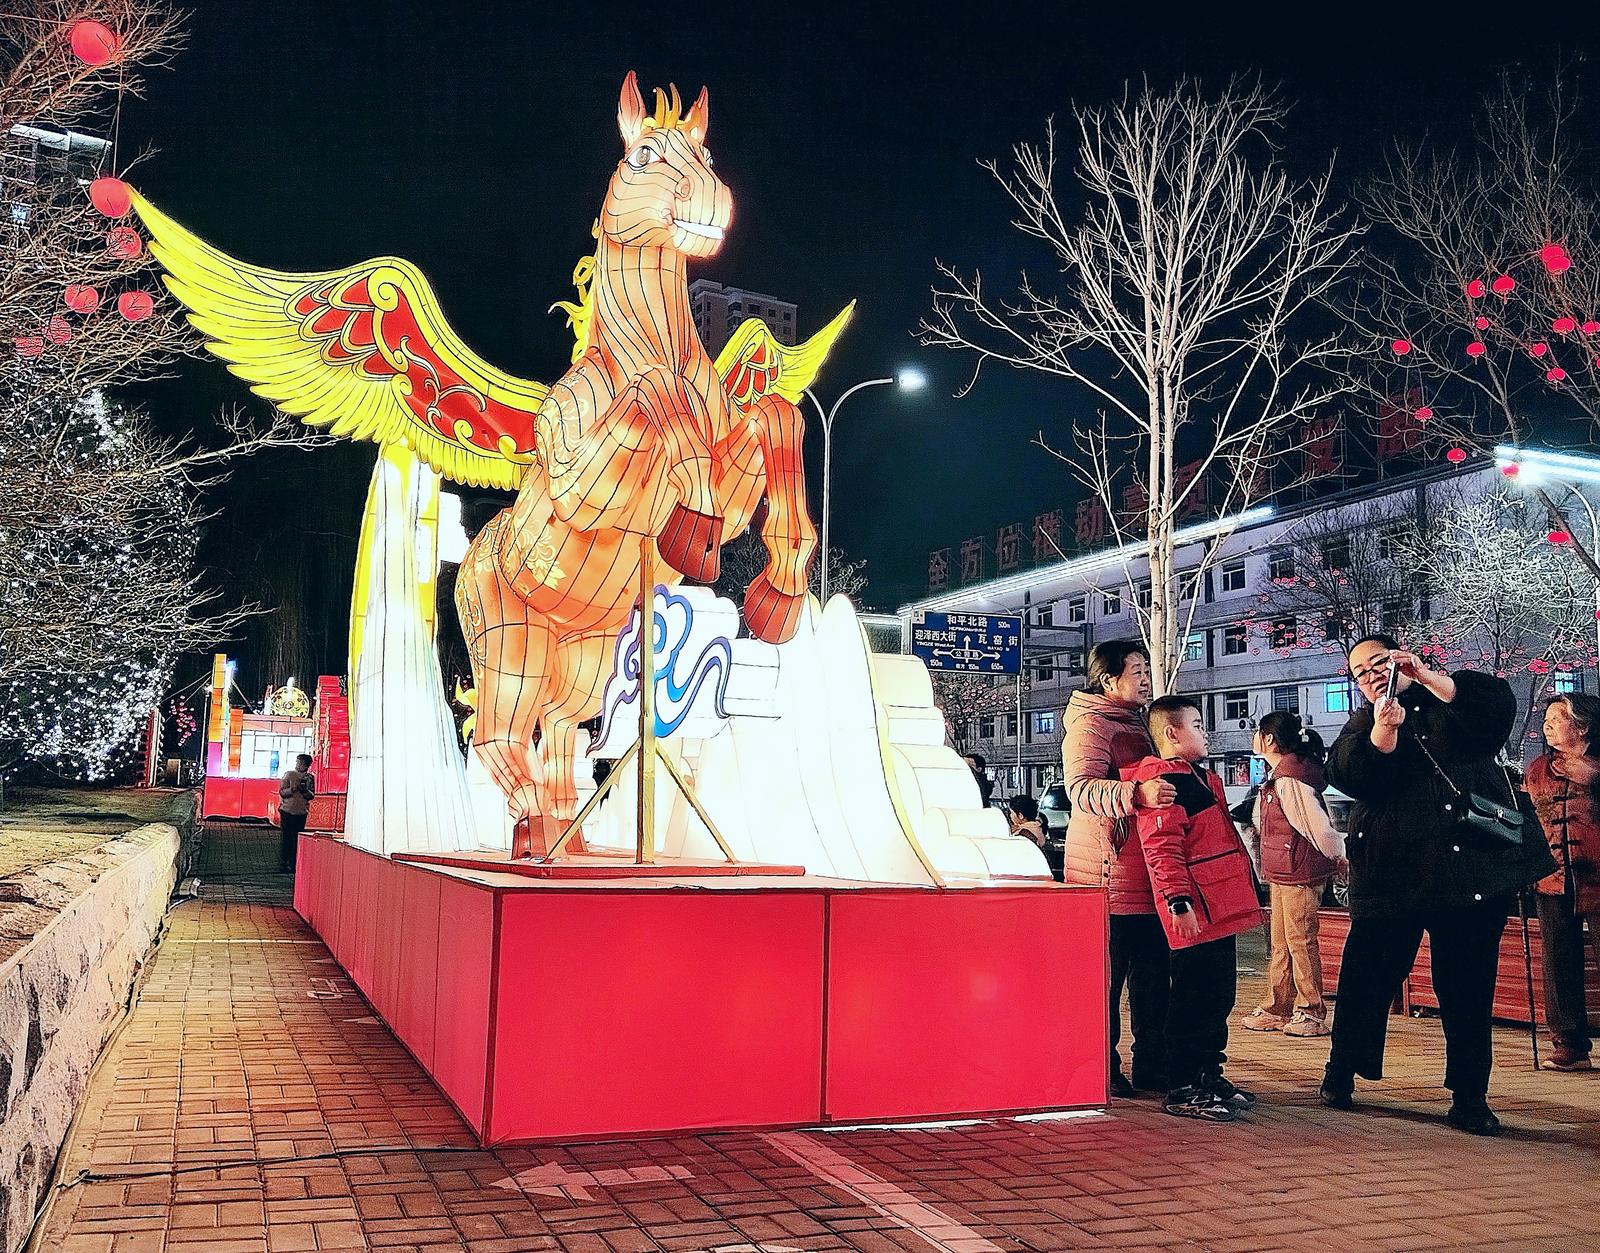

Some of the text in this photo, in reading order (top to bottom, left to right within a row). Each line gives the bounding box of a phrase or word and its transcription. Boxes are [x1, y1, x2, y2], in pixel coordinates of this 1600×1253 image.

[947, 615, 988, 627] 和平北路
[914, 629, 957, 642] 迎泽西大街
[977, 633, 1018, 646] 瓦窑街
